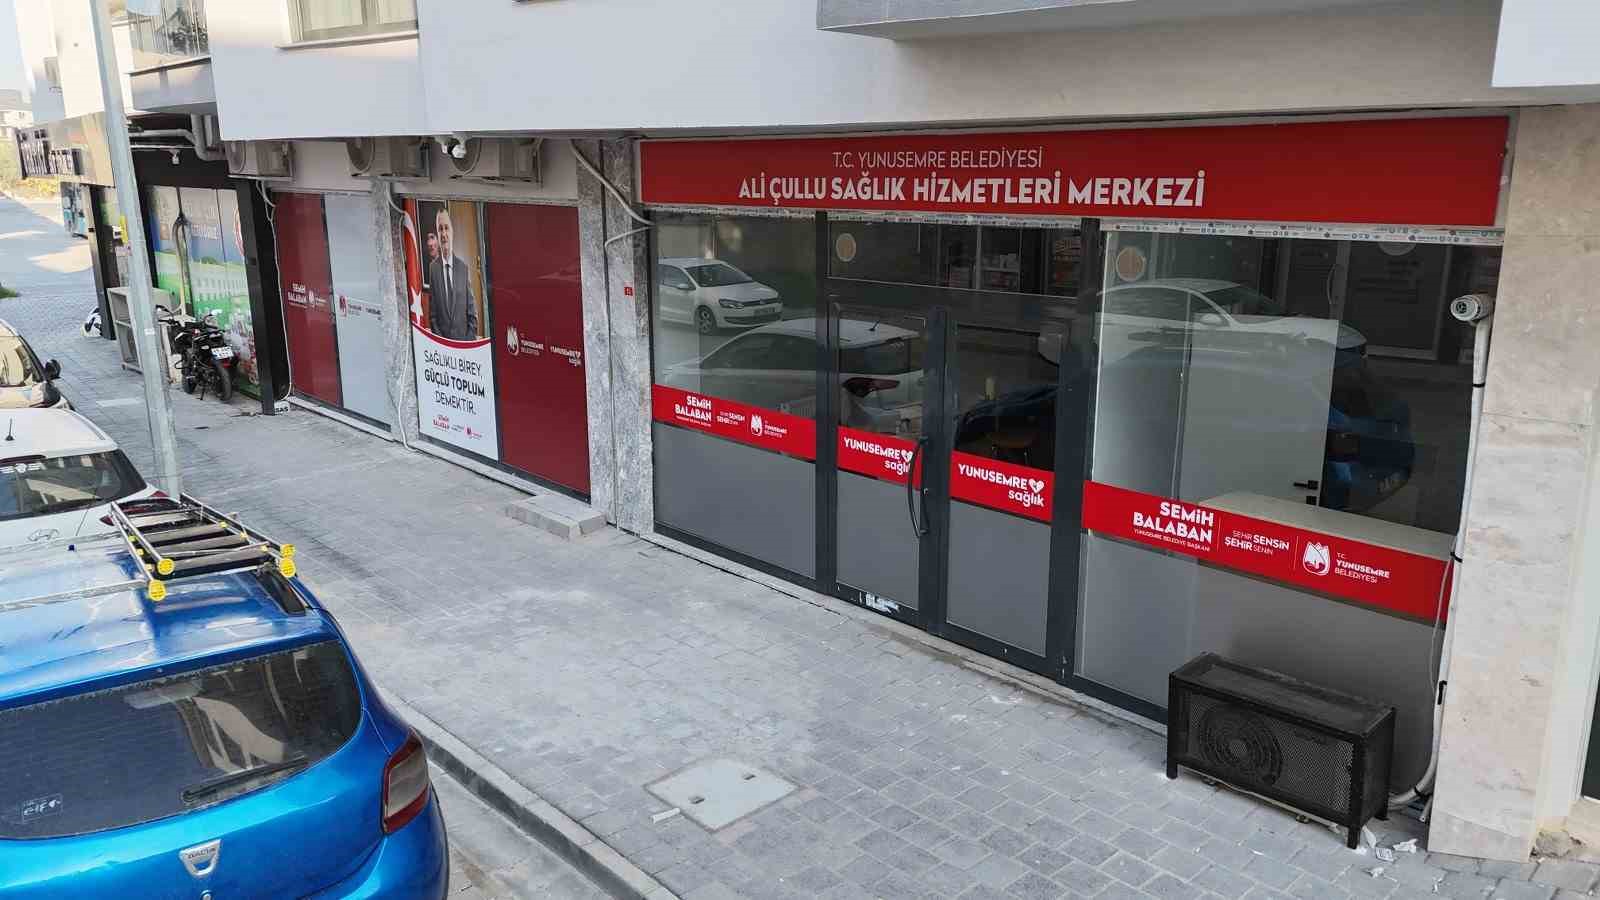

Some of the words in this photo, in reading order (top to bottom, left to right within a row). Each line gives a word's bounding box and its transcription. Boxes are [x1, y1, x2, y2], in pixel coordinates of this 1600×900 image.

[832, 151, 854, 168] T.C.
[858, 151, 946, 168] YUNUSEMRE
[950, 146, 1042, 168] BELEDİYESİ
[739, 171, 766, 199] ALİ
[769, 177, 827, 206] ÇULLU
[830, 170, 906, 201] SAĞLIK
[913, 170, 1061, 204] HİZMETLERİ
[1068, 169, 1206, 207] MERKEZİ
[424, 350, 457, 370] SAĞLIKLI
[424, 368, 450, 388] GÜÇLÜ
[450, 376, 485, 398] TOPLUM
[674, 404, 712, 422] BALABAN
[686, 395, 712, 410] SEMİH
[843, 437, 901, 460] YUNUSEMRE
[958, 463, 1028, 490] YUNUSEMRE
[1008, 488, 1044, 507] sağlık
[1160, 501, 1214, 527] SEMİH
[1133, 511, 1212, 544] BALABAN
[1225, 536, 1253, 551] ŞEHİR
[1253, 534, 1290, 550] SENSİN
[1336, 559, 1390, 578] YUNUSEMRE
